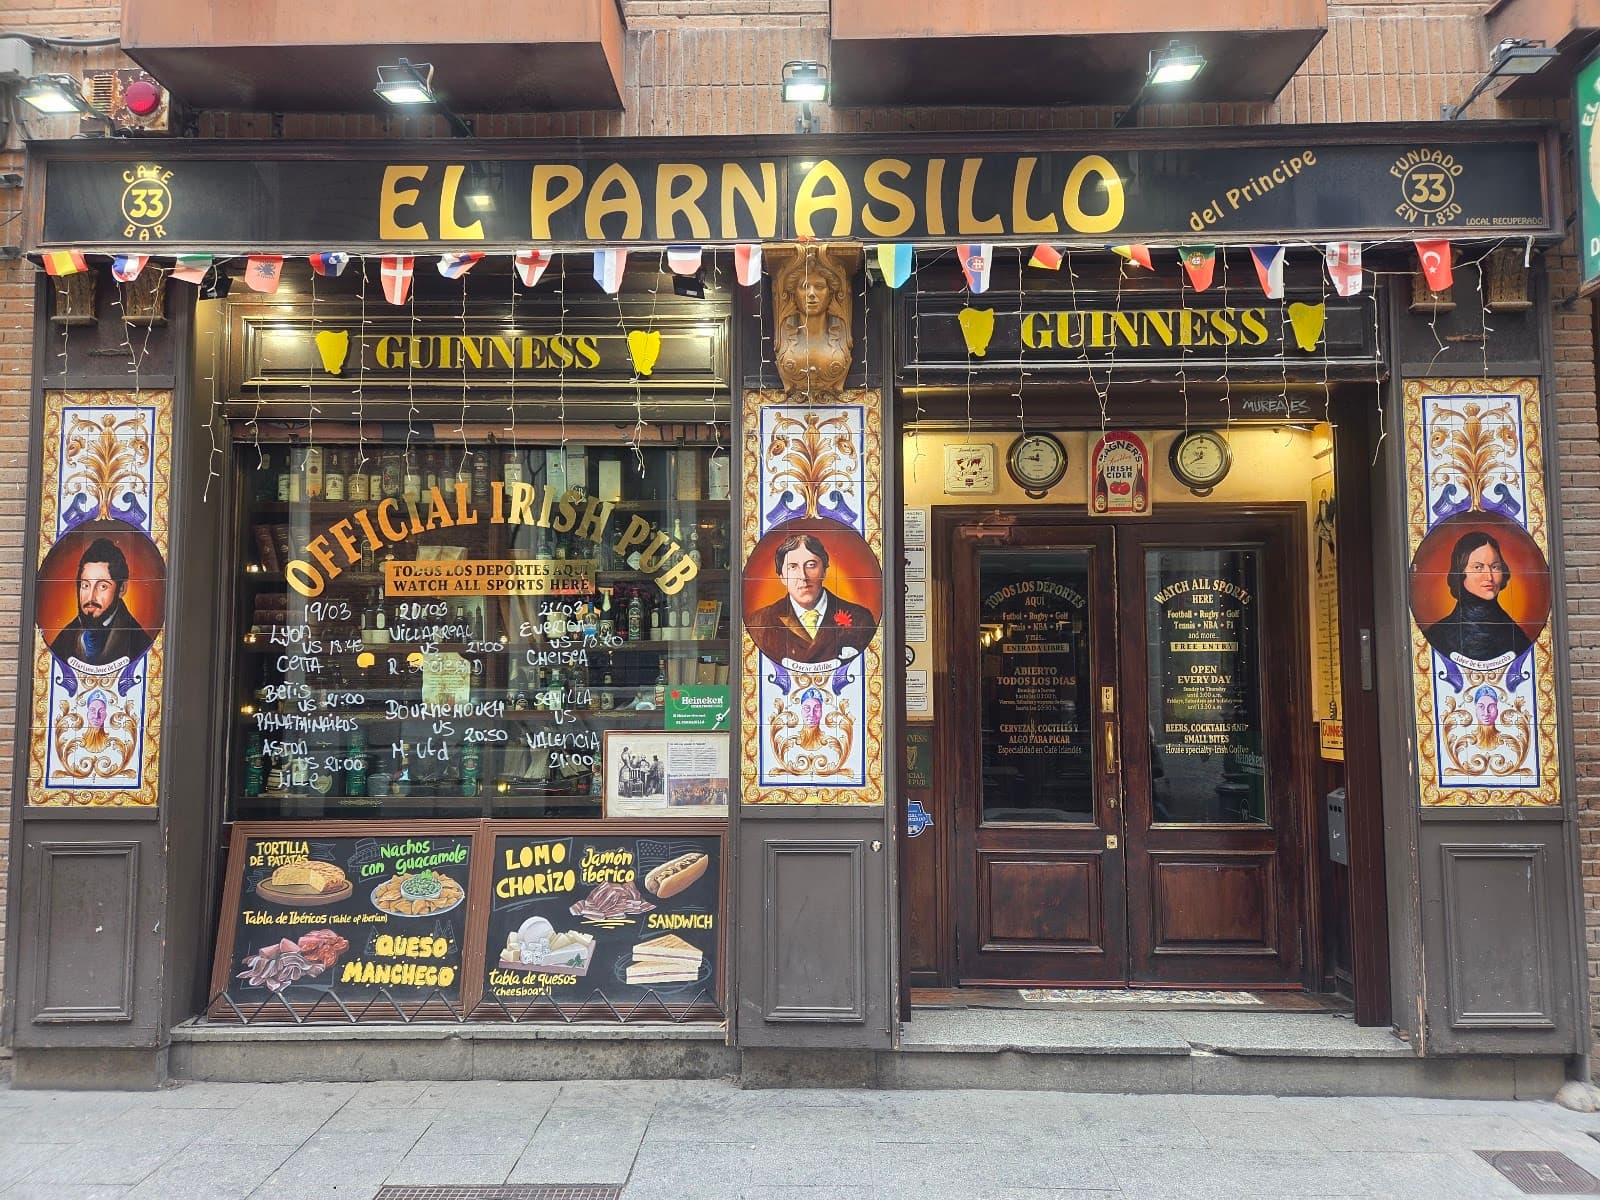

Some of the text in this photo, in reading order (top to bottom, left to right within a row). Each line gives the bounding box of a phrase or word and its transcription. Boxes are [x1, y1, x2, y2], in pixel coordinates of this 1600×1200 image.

[1389, 148, 1465, 178] FUNDADO
[123, 164, 175, 184] CAFE
[1189, 149, 1317, 232] del Principe
[1411, 173, 1447, 203] 33
[130, 188, 163, 218] 33
[380, 155, 1126, 240] EL PARNASILLO
[1394, 203, 1418, 223] EN
[1466, 216, 1543, 226] LOCAL RECUPERADO
[123, 223, 167, 241] BAR
[1021, 308, 1268, 350] GUINNESS
[376, 335, 602, 370] GUINNESS
[286, 481, 699, 597] OFFICIAL IRISH PUB
[393, 565, 442, 577] TODOS
[446, 565, 472, 577] LOS
[476, 565, 550, 577] DEPORTES
[393, 579, 589, 591] WATCH ALL SPORTS HERE
[1153, 578, 1251, 605] WATCH ALL SPORTS
[985, 580, 1086, 609] TODOS LOS DEPORTES
[1192, 594, 1214, 604] HERE
[304, 601, 352, 623] 19/03
[399, 601, 448, 621] 20/03
[1167, 609, 1240, 620] Football Rugby Golf
[1173, 620, 1196, 630] Tennis
[1203, 620, 1218, 629] NBA
[269, 624, 312, 647] Lyon
[329, 638, 365, 656] 18:45
[465, 641, 505, 653] 21:00
[387, 657, 405, 675] R.
[791, 662, 811, 672] Oscar
[1014, 666, 1058, 676] ABIERTO
[1190, 665, 1218, 674] OPEN
[996, 676, 1031, 686] TODOS
[1031, 676, 1051, 686] LOS
[1177, 675, 1232, 684] EVERY DAY
[320, 692, 365, 708] 21:00
[681, 695, 723, 705] Heineken
[1165, 723, 1247, 733] BEERS, COCKTAILS AND
[1008, 735, 1071, 744] ALGO PARA PICAR
[1184, 735, 1230, 744] SMALL BITES
[391, 739, 409, 759] M.
[1165, 745, 1185, 754] House
[1214, 745, 1229, 754] Irish
[323, 755, 363, 772] 21:00
[548, 752, 594, 769] 21:00
[256, 841, 309, 855] TORTILLA
[380, 839, 431, 859] Nachos
[505, 842, 567, 871] LOMO
[249, 854, 309, 867] DE PATATAS
[581, 848, 633, 868] Jamón
[361, 862, 385, 877] con
[582, 864, 635, 884] ibérico
[242, 910, 274, 925] Tabla
[275, 911, 288, 925] de
[288, 910, 327, 925] Ibéricos
[352, 914, 361, 926] of
[647, 913, 713, 930] SANDWICH
[375, 934, 449, 958] QUESO
[341, 961, 455, 988] MANCHEGO
[488, 968, 577, 987] tabla de quesos
